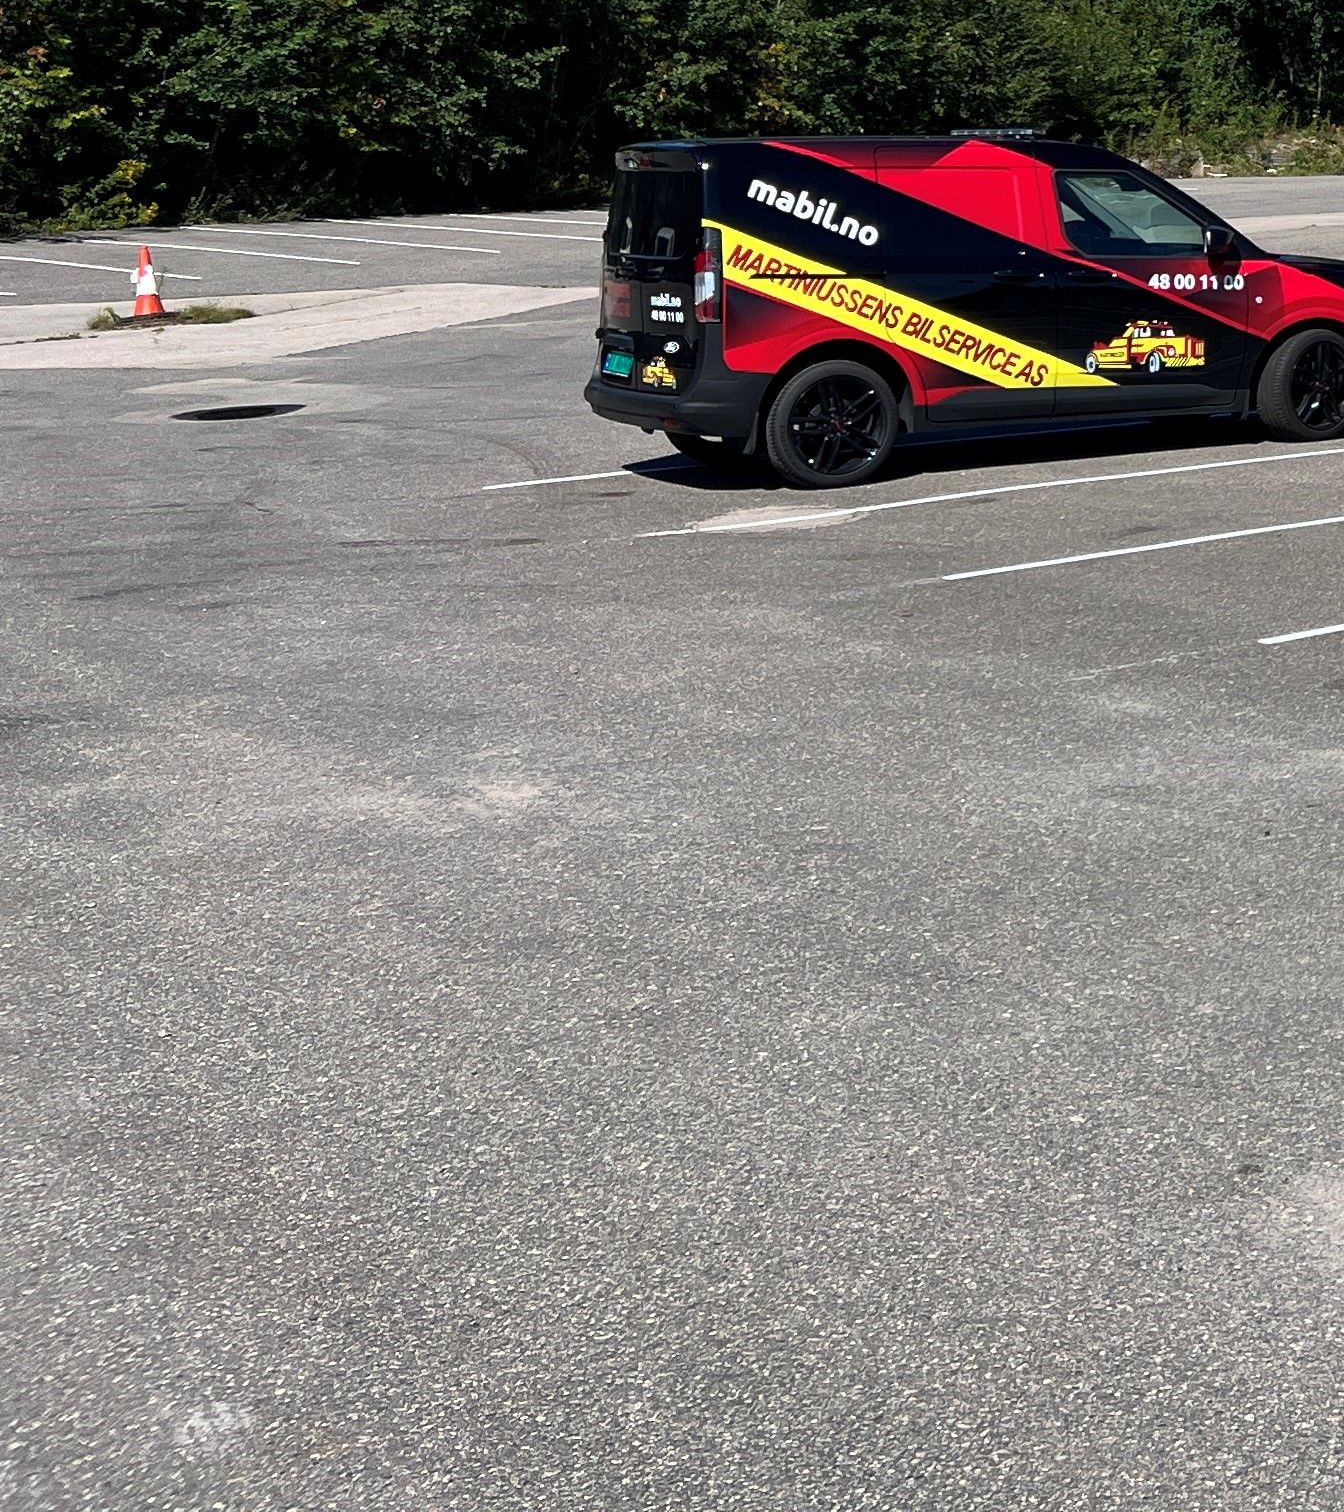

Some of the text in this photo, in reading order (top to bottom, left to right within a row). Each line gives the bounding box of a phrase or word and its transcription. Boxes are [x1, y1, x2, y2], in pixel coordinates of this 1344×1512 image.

[747, 179, 879, 246] mabil.no
[726, 244, 1050, 387] MARTINIUSSENS BILSERVICE AS
[1148, 273, 1245, 291] 48 00 11 00
